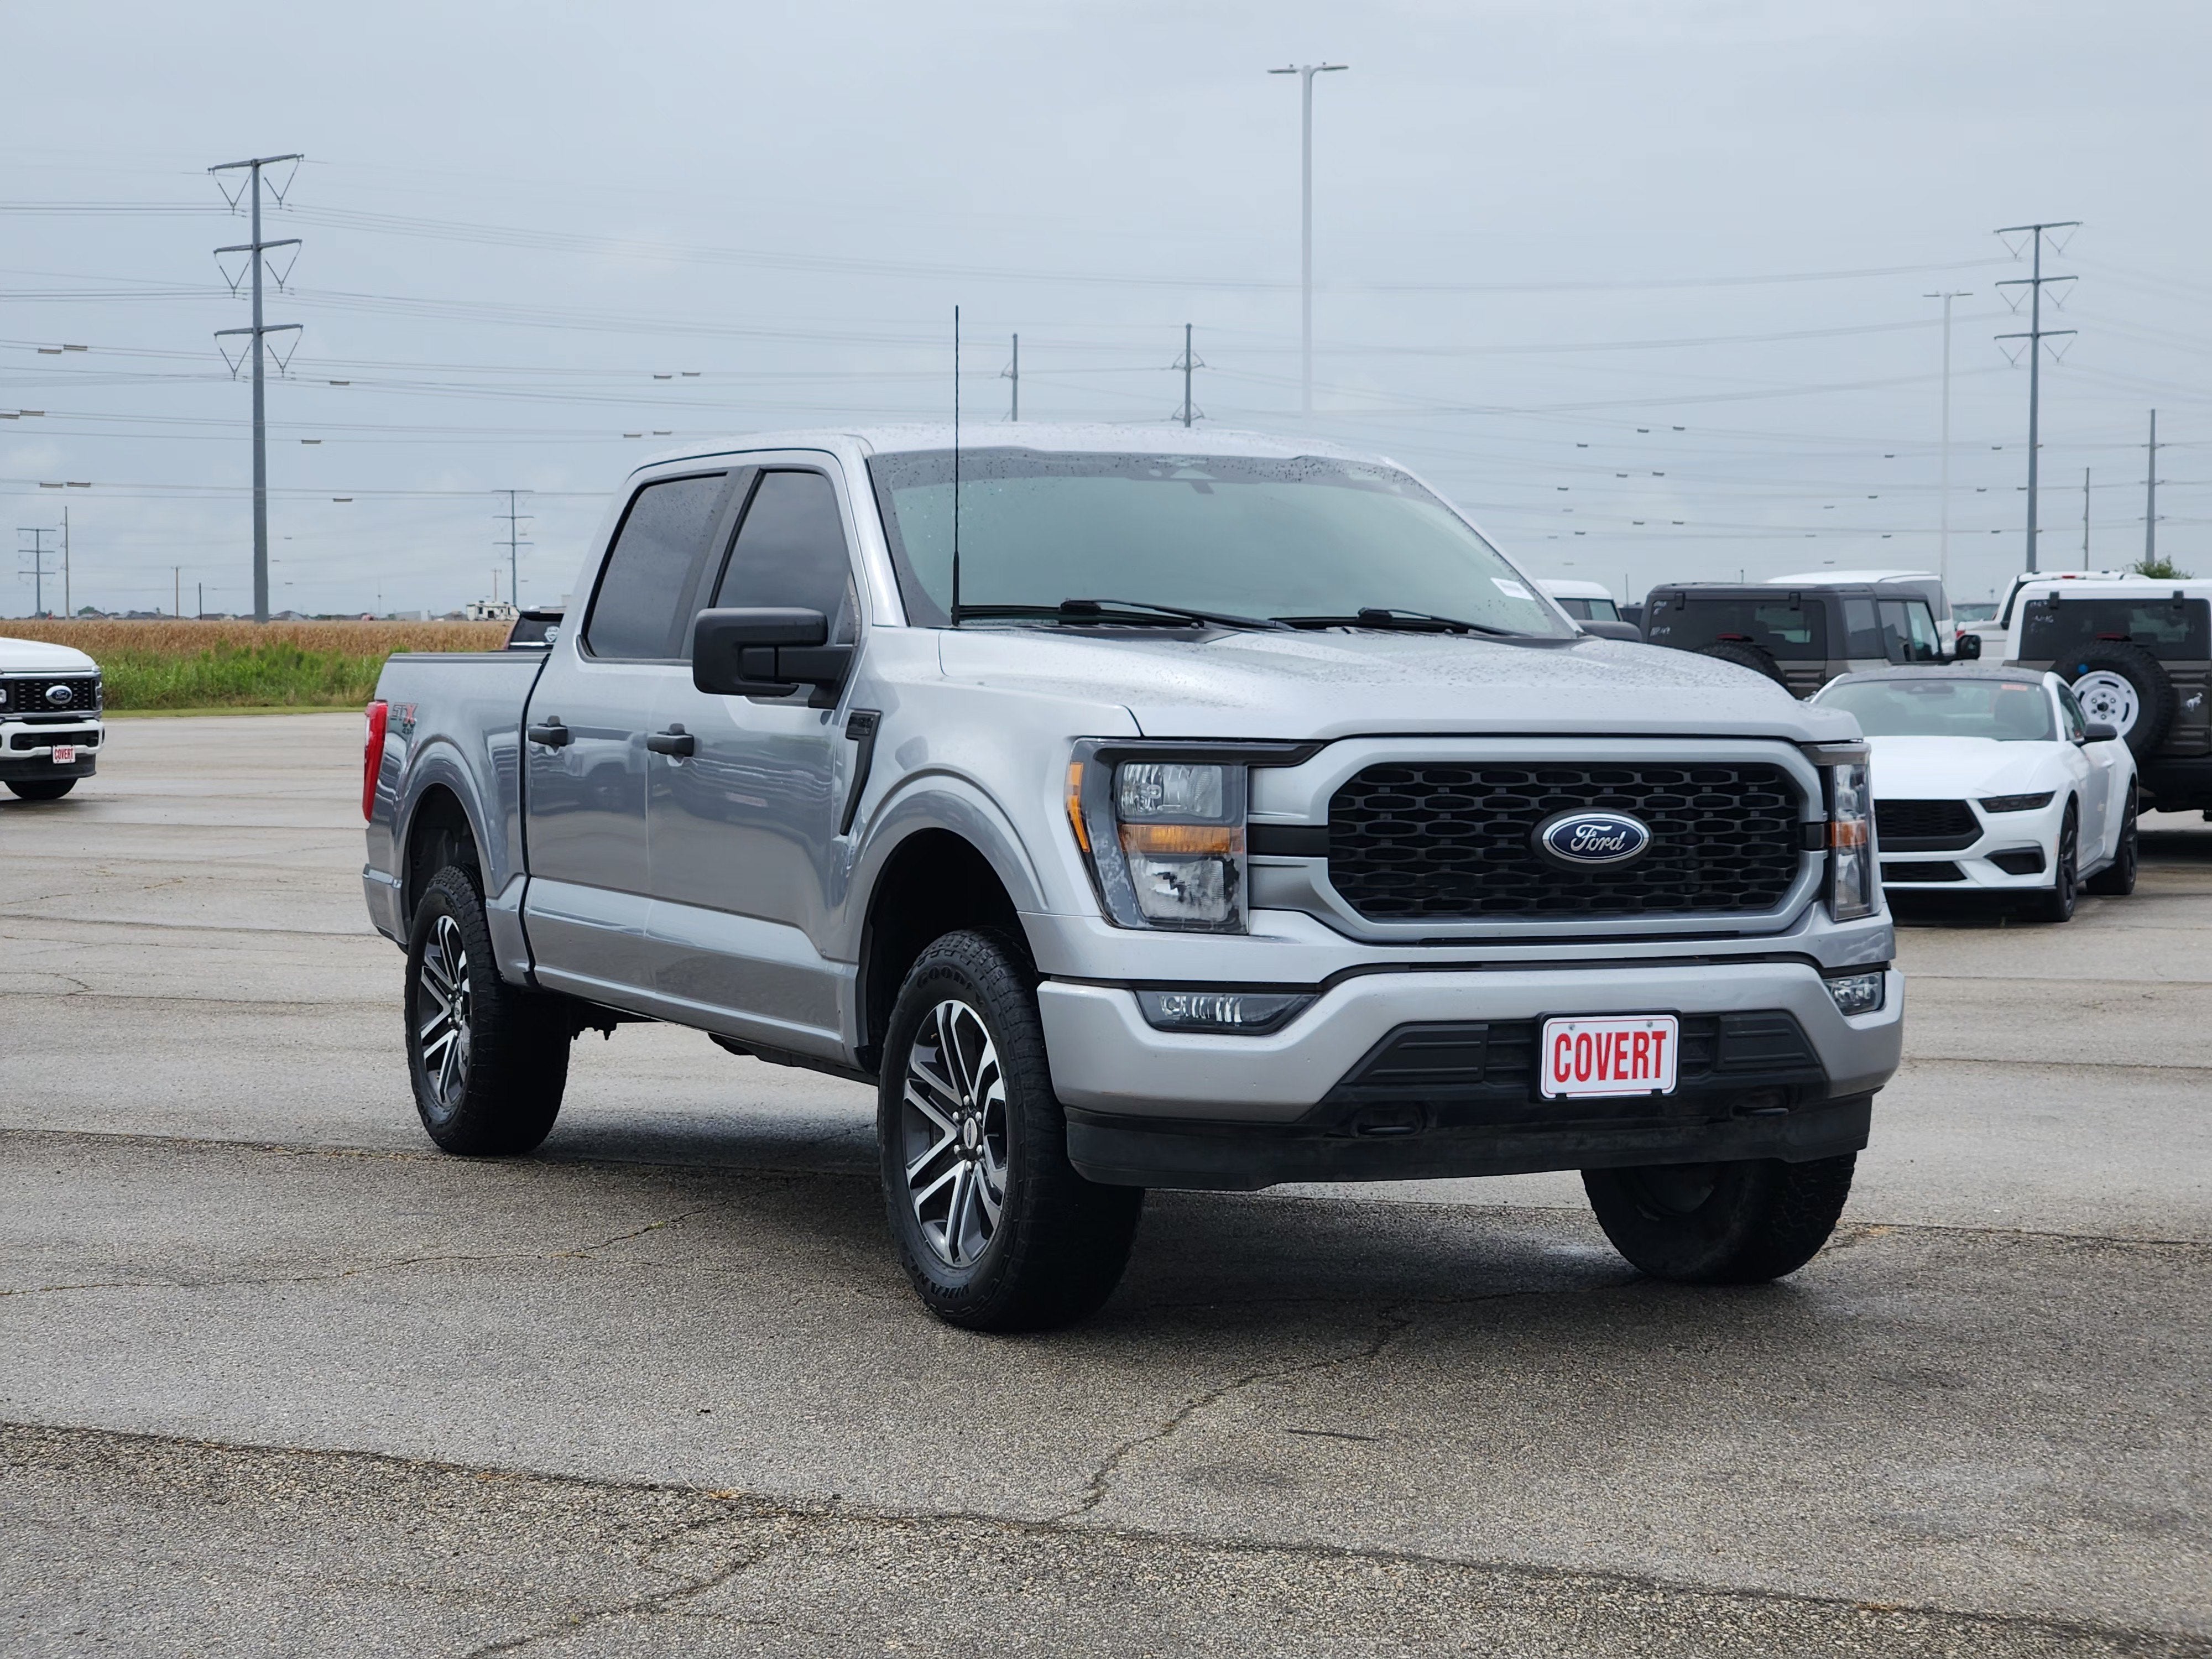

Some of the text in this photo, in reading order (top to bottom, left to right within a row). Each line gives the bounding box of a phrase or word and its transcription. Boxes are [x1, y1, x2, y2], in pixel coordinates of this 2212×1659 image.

[390, 702, 419, 728] STX
[54, 748, 74, 760] COVERT
[1570, 824, 1627, 852] Ford
[1554, 1030, 1667, 1083] COVERT
